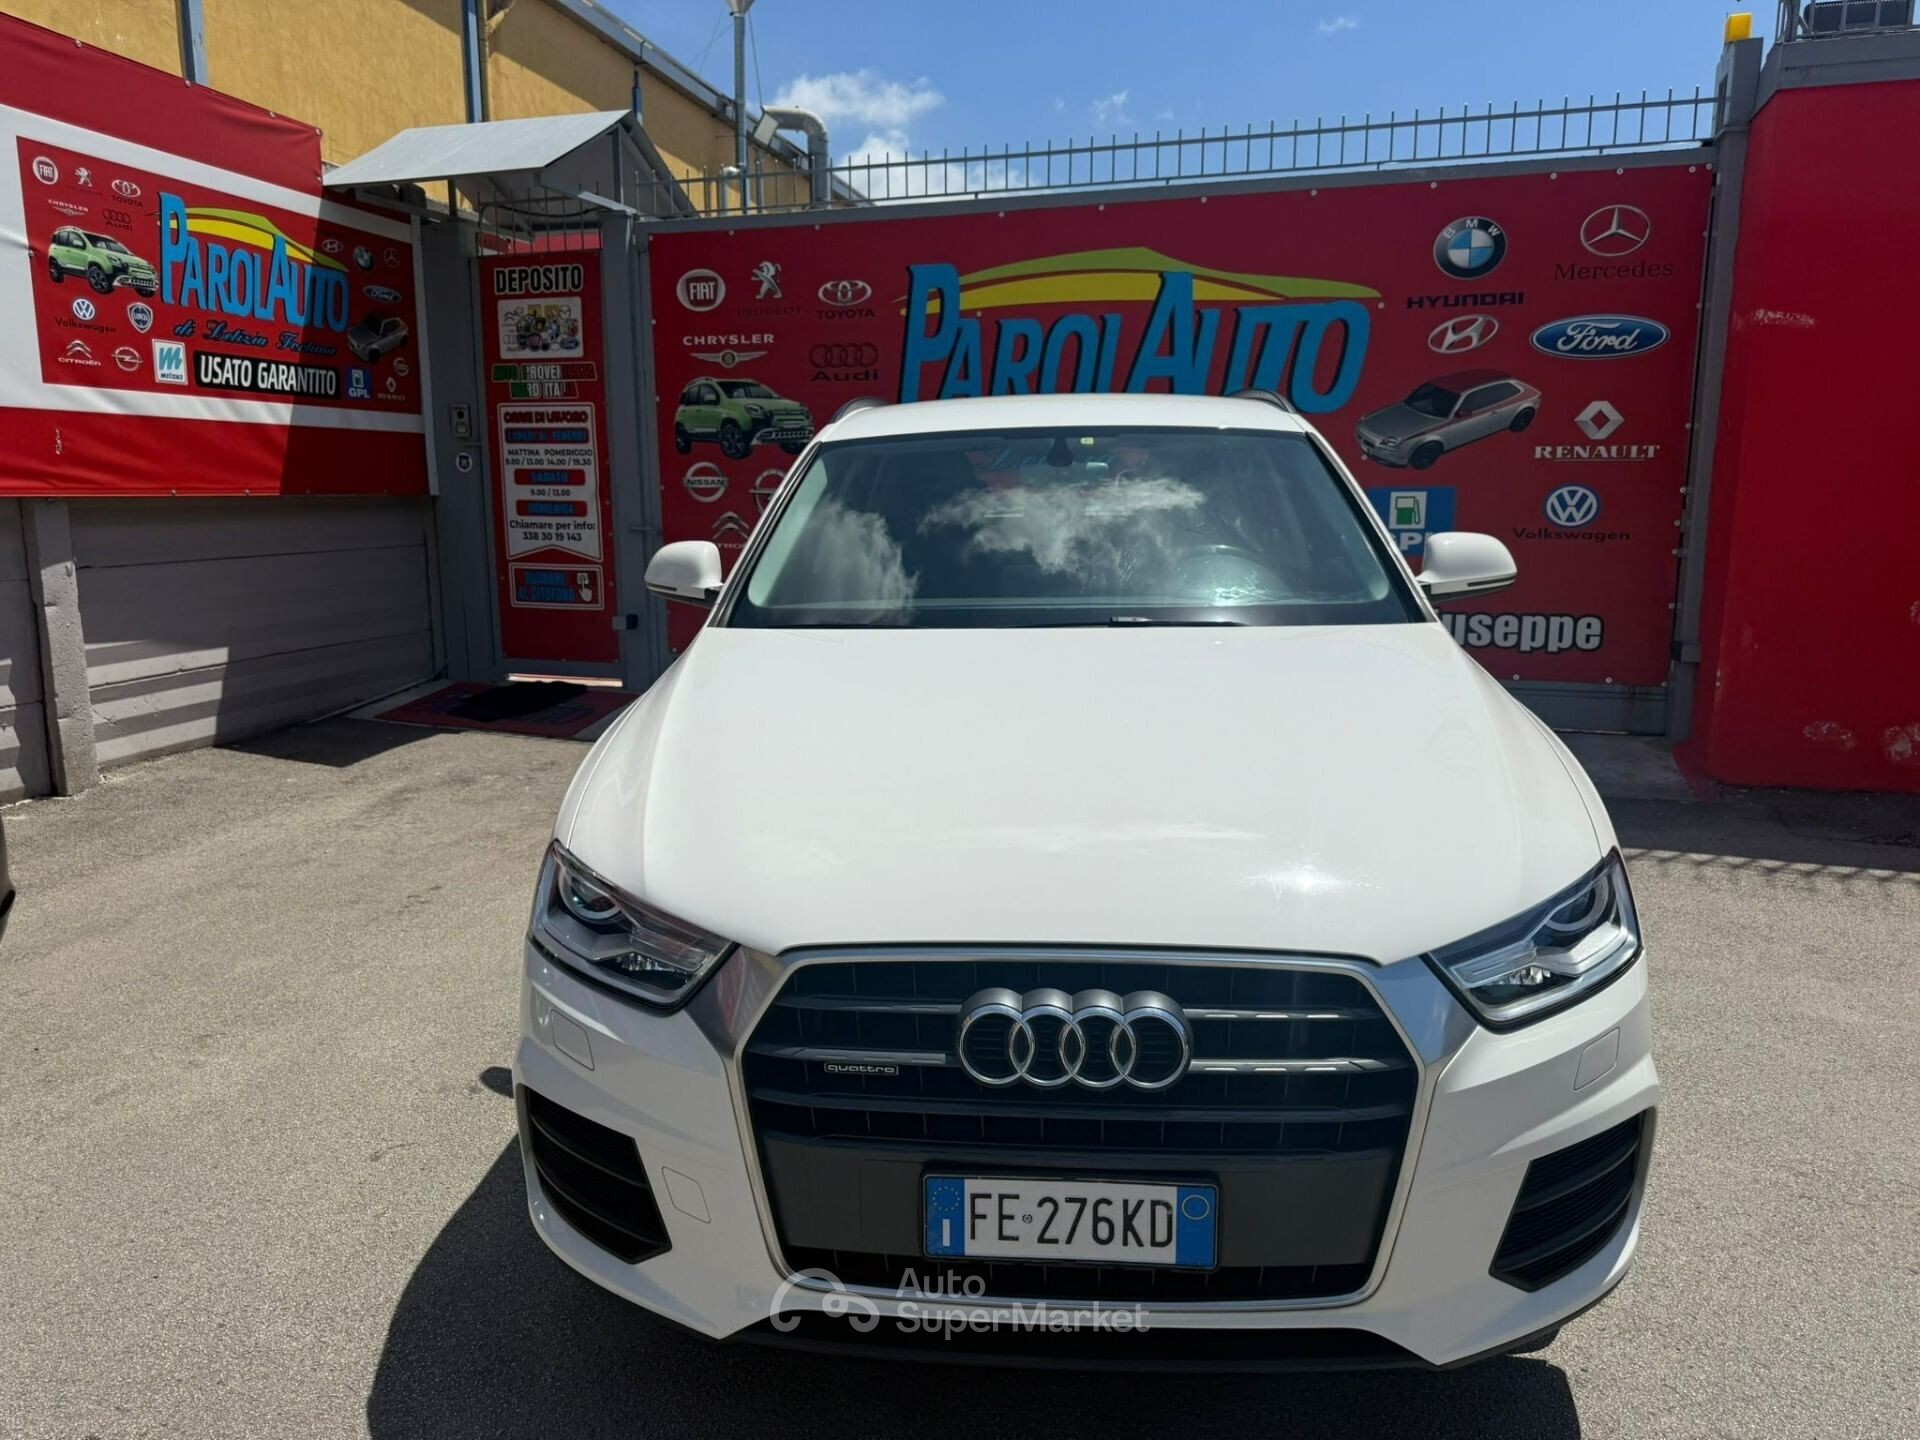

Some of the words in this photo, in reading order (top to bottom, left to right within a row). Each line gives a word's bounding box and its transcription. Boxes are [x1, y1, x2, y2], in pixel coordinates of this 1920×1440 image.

[39, 164, 54, 180] FIAT
[48, 199, 89, 212] CHRYSLER
[111, 195, 144, 208] TOYOTA
[1553, 261, 1674, 282] Mercedes
[494, 264, 584, 295] DEPOSITO
[688, 280, 716, 300] FIAT
[1406, 291, 1525, 310] HYUNDAI
[816, 308, 876, 320] TOYOTA
[54, 316, 117, 334] Volkswagen
[682, 333, 775, 346] CHRYSLER
[1556, 320, 1641, 351] Ford
[199, 354, 252, 386] USATO
[257, 361, 337, 396] GARANTITO
[810, 369, 879, 382] Audi
[349, 387, 371, 399] GPL
[507, 448, 540, 457] MATTINA
[544, 448, 593, 457] POMERIGGIO
[1534, 445, 1661, 459] RENAULT
[686, 478, 726, 487] NISSAN
[509, 519, 554, 530] Chiamare
[555, 522, 572, 532] per
[574, 520, 596, 531] info:
[522, 531, 539, 541] 338
[541, 532, 553, 541] 30
[554, 532, 565, 542] 19
[566, 532, 583, 542] 143
[1512, 527, 1631, 542] Volkswagen
[826, 1061, 898, 1075] quattro
[968, 1192, 1021, 1242] FE
[1036, 1197, 1174, 1249] 276KD
